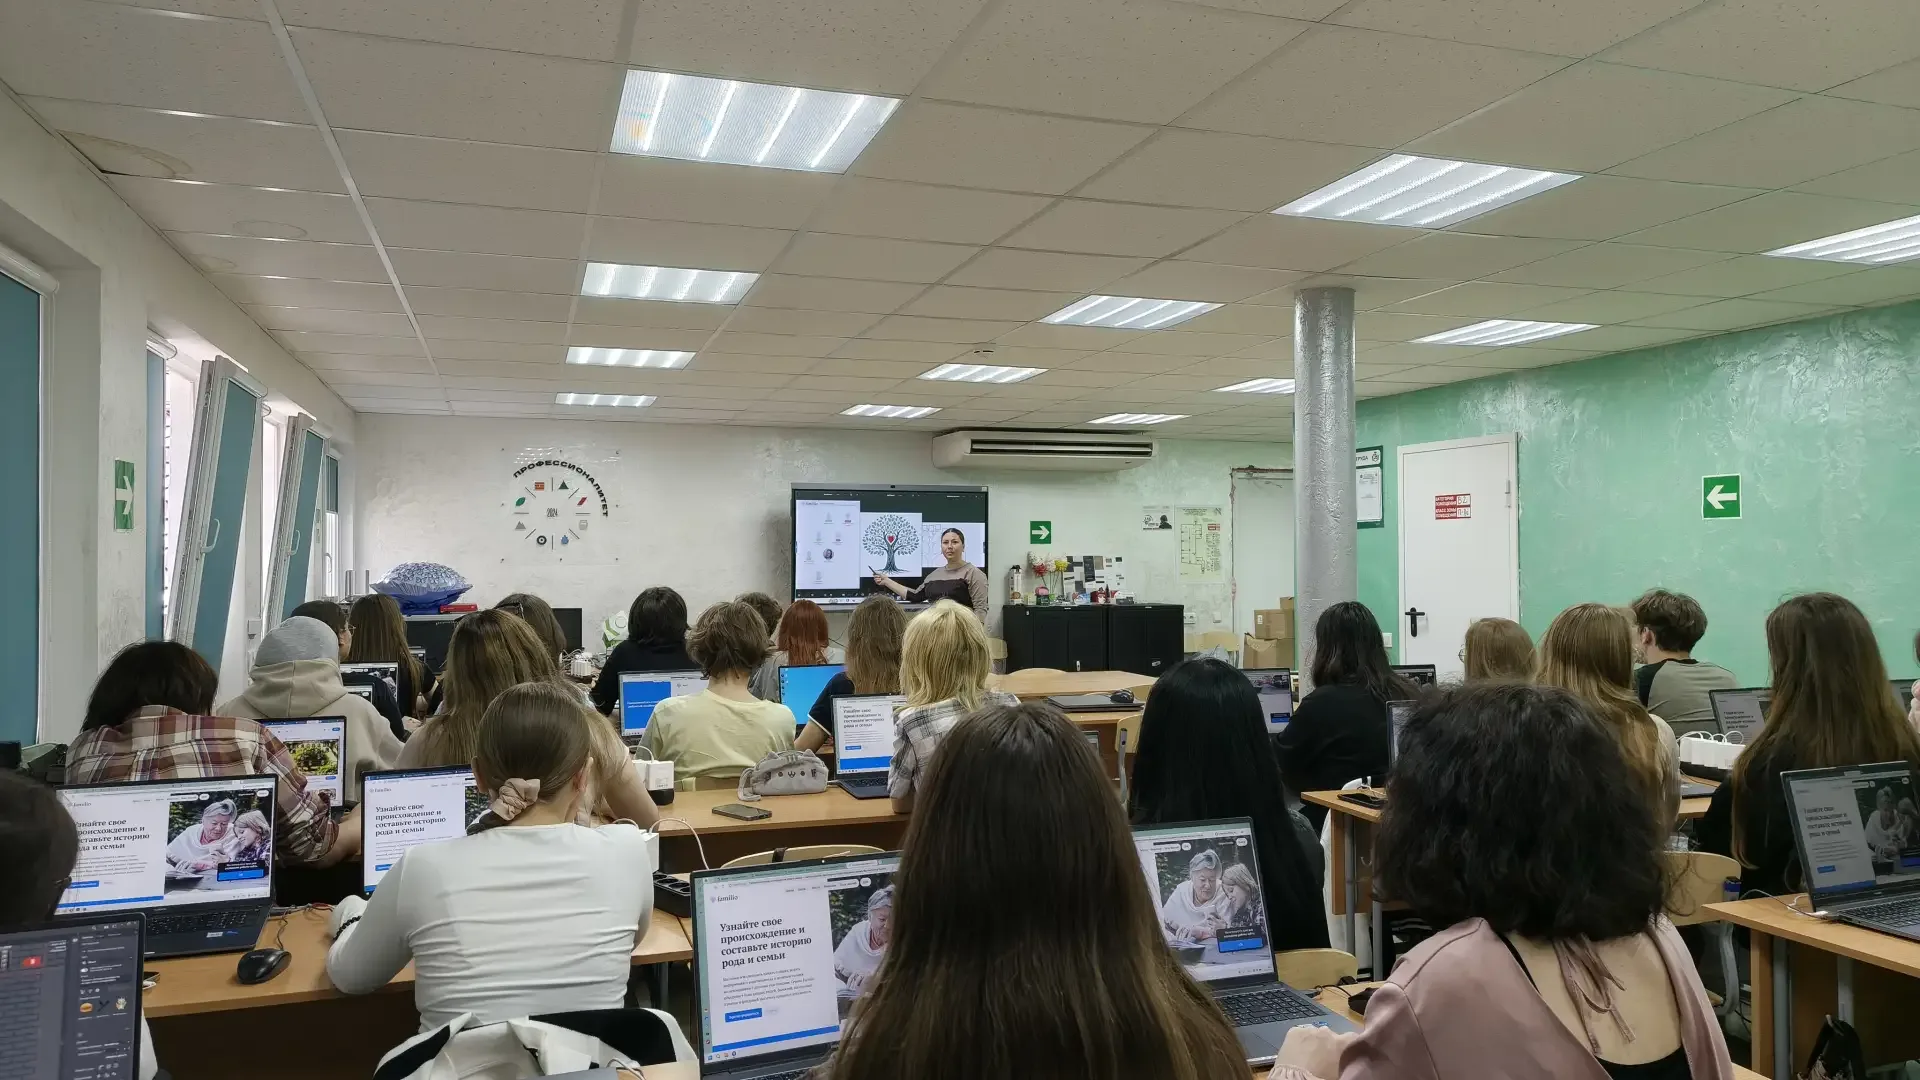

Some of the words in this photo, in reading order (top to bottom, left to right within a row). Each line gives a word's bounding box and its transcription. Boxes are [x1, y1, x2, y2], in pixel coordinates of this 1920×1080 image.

[512, 460, 608, 518] ПРОФЕССИОНАЛИТЕТ
[546, 507, 558, 518] 2024
[78, 826, 137, 836] роисхождение
[113, 834, 150, 843] историю
[720, 919, 759, 932] Узнайте
[761, 917, 783, 926] свое
[721, 928, 797, 944] происхождение
[721, 944, 768, 956] составьте
[770, 937, 812, 950] историю
[722, 958, 745, 969] рода
[756, 952, 786, 962] семьи
